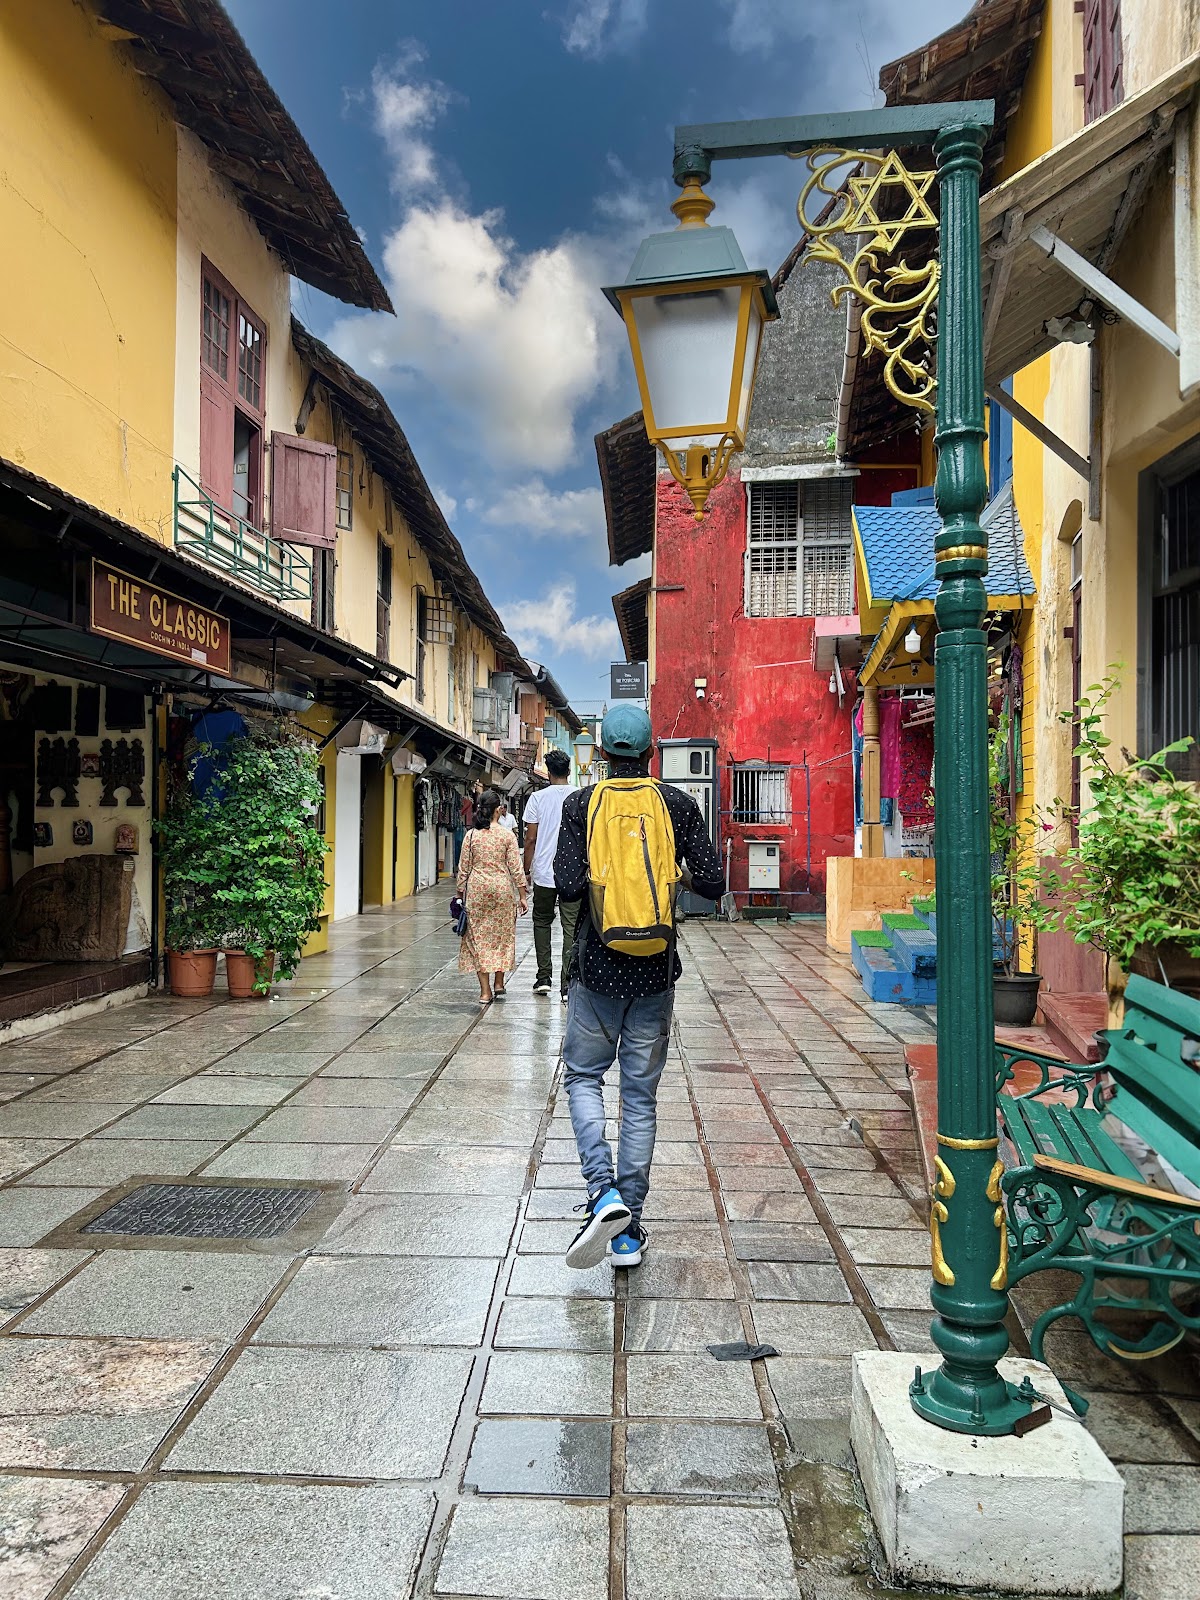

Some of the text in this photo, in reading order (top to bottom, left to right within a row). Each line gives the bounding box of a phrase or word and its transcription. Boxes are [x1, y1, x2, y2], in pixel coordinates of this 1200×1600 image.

[108, 574, 220, 650] THE CLASSIC
[176, 640, 191, 653] INDIA
